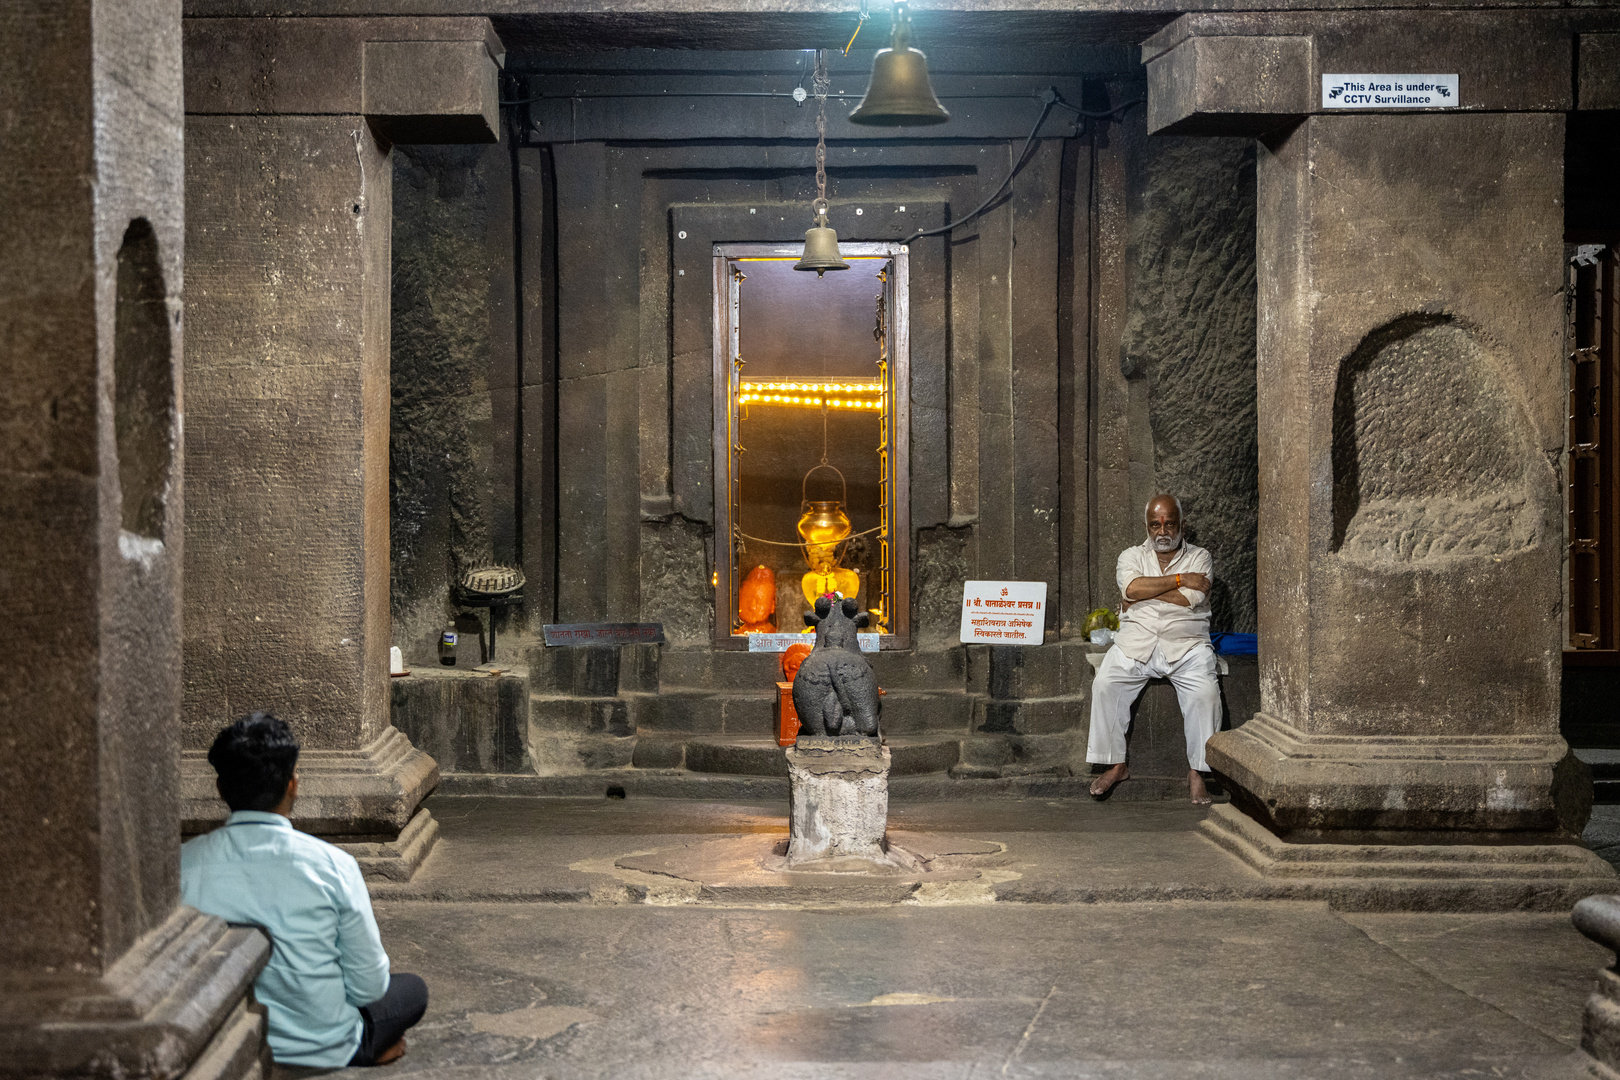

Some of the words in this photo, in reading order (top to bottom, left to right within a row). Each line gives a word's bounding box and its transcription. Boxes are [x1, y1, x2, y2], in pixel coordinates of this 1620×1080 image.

[1343, 83, 1366, 92] This
[1368, 83, 1392, 92] Area
[1395, 83, 1403, 92] is
[1406, 83, 1435, 92] under
[1343, 95, 1372, 104] CCTV
[1374, 95, 1431, 104] Survillance
[985, 598, 1016, 609] पाताळेश्वर
[1017, 601, 1034, 609] प्रसन्न
[1007, 618, 1033, 628] अभिषेक
